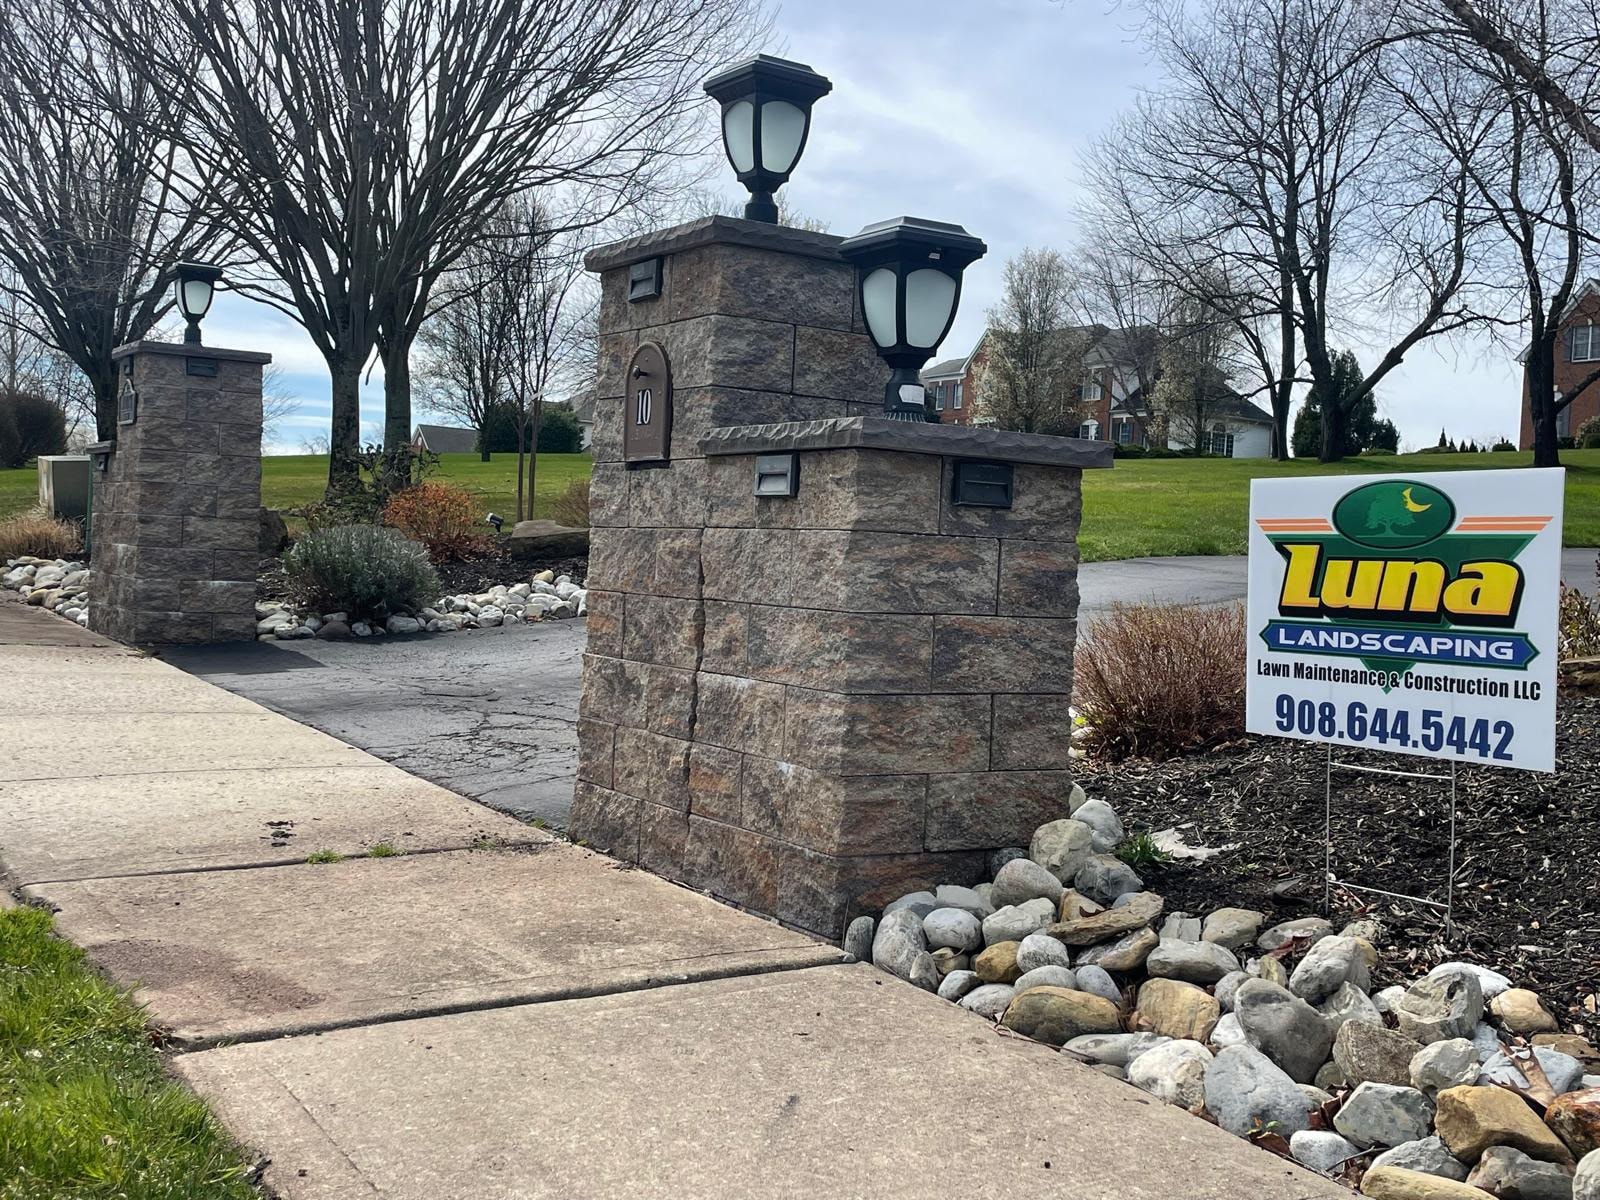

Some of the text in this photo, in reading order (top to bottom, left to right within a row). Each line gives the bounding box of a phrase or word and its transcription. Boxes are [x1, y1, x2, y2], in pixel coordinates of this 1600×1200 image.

[637, 389, 651, 424] 10
[1278, 543, 1522, 620] Luna
[1278, 628, 1514, 660] LANDSCAPING
[1257, 659, 1541, 701] Lawn Maintenance & Construction LLC
[1275, 694, 1514, 761] 908.644.5442
